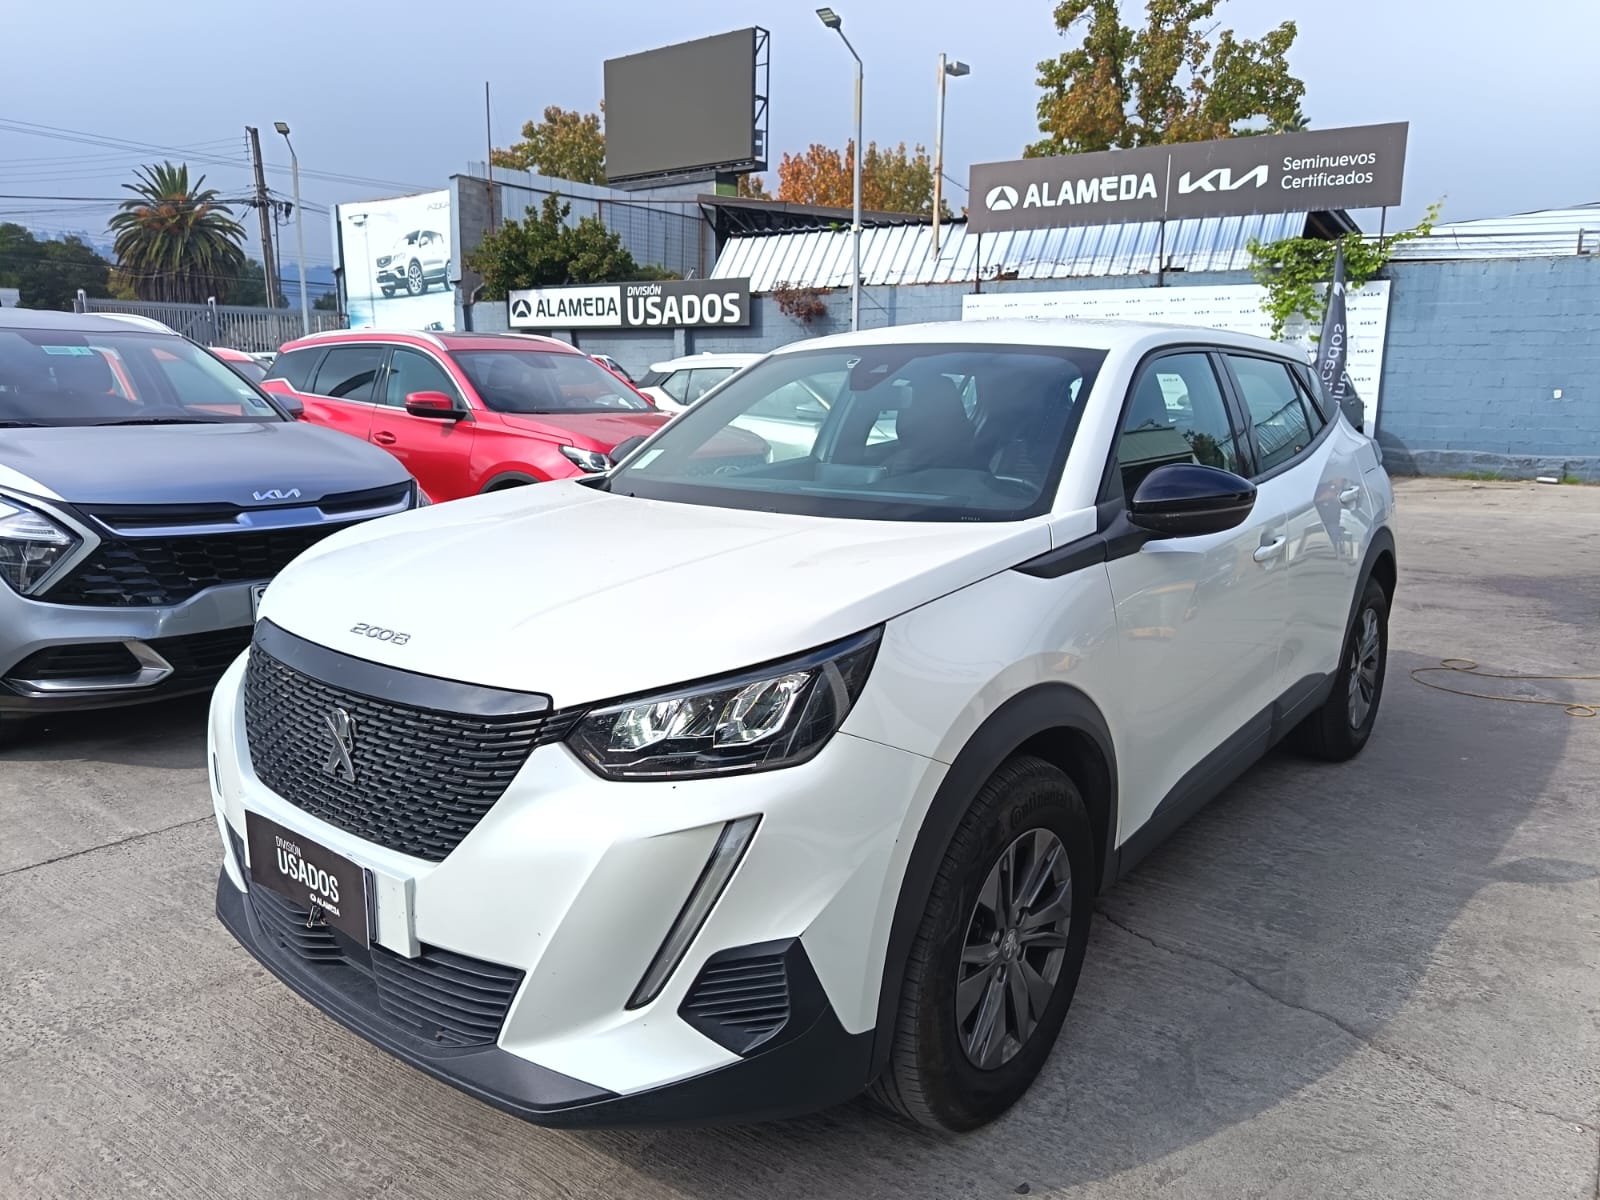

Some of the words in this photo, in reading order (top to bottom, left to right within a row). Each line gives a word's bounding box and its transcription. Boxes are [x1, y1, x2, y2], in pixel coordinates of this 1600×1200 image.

[1282, 152, 1376, 171] Seminuevos
[1022, 173, 1158, 208] ALAMEDA
[1178, 165, 1269, 193] KIA
[1281, 169, 1374, 189] Certificados
[627, 284, 662, 296] DIVISIÓN
[536, 297, 618, 318] ALAMEDA
[627, 293, 741, 326] USADOS
[349, 622, 411, 646] 2008
[275, 835, 302, 857] DIVISIÓN
[276, 848, 340, 903] USADOS
